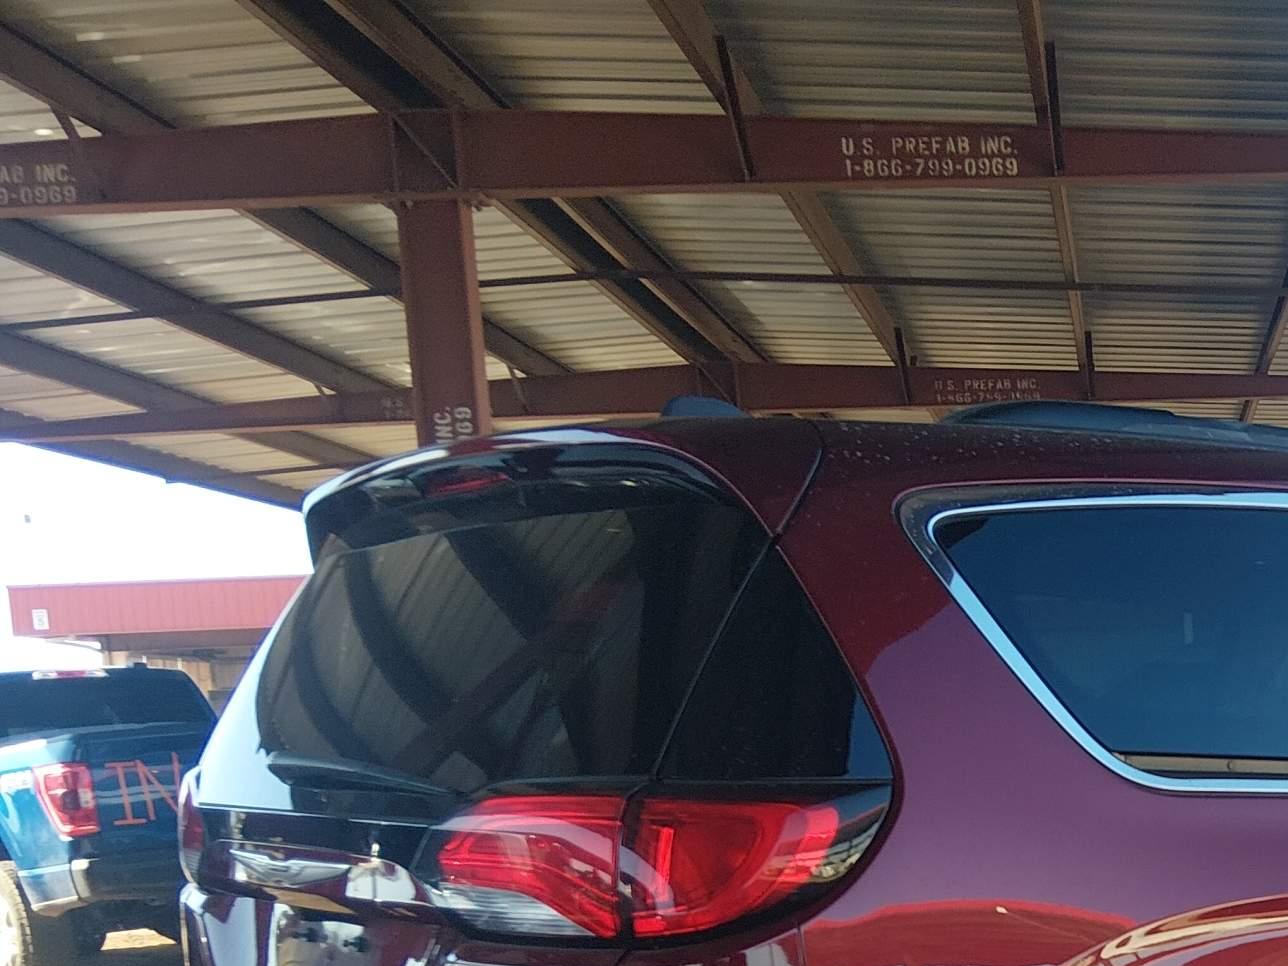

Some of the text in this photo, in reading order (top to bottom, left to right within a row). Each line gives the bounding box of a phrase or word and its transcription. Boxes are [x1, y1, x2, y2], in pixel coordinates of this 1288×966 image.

[841, 136, 1018, 156] U.S. PREFAB INC.
[35, 163, 76, 183] INC.
[846, 157, 1019, 177] 1-866-799-0969
[964, 378, 1012, 390] PREFAB
